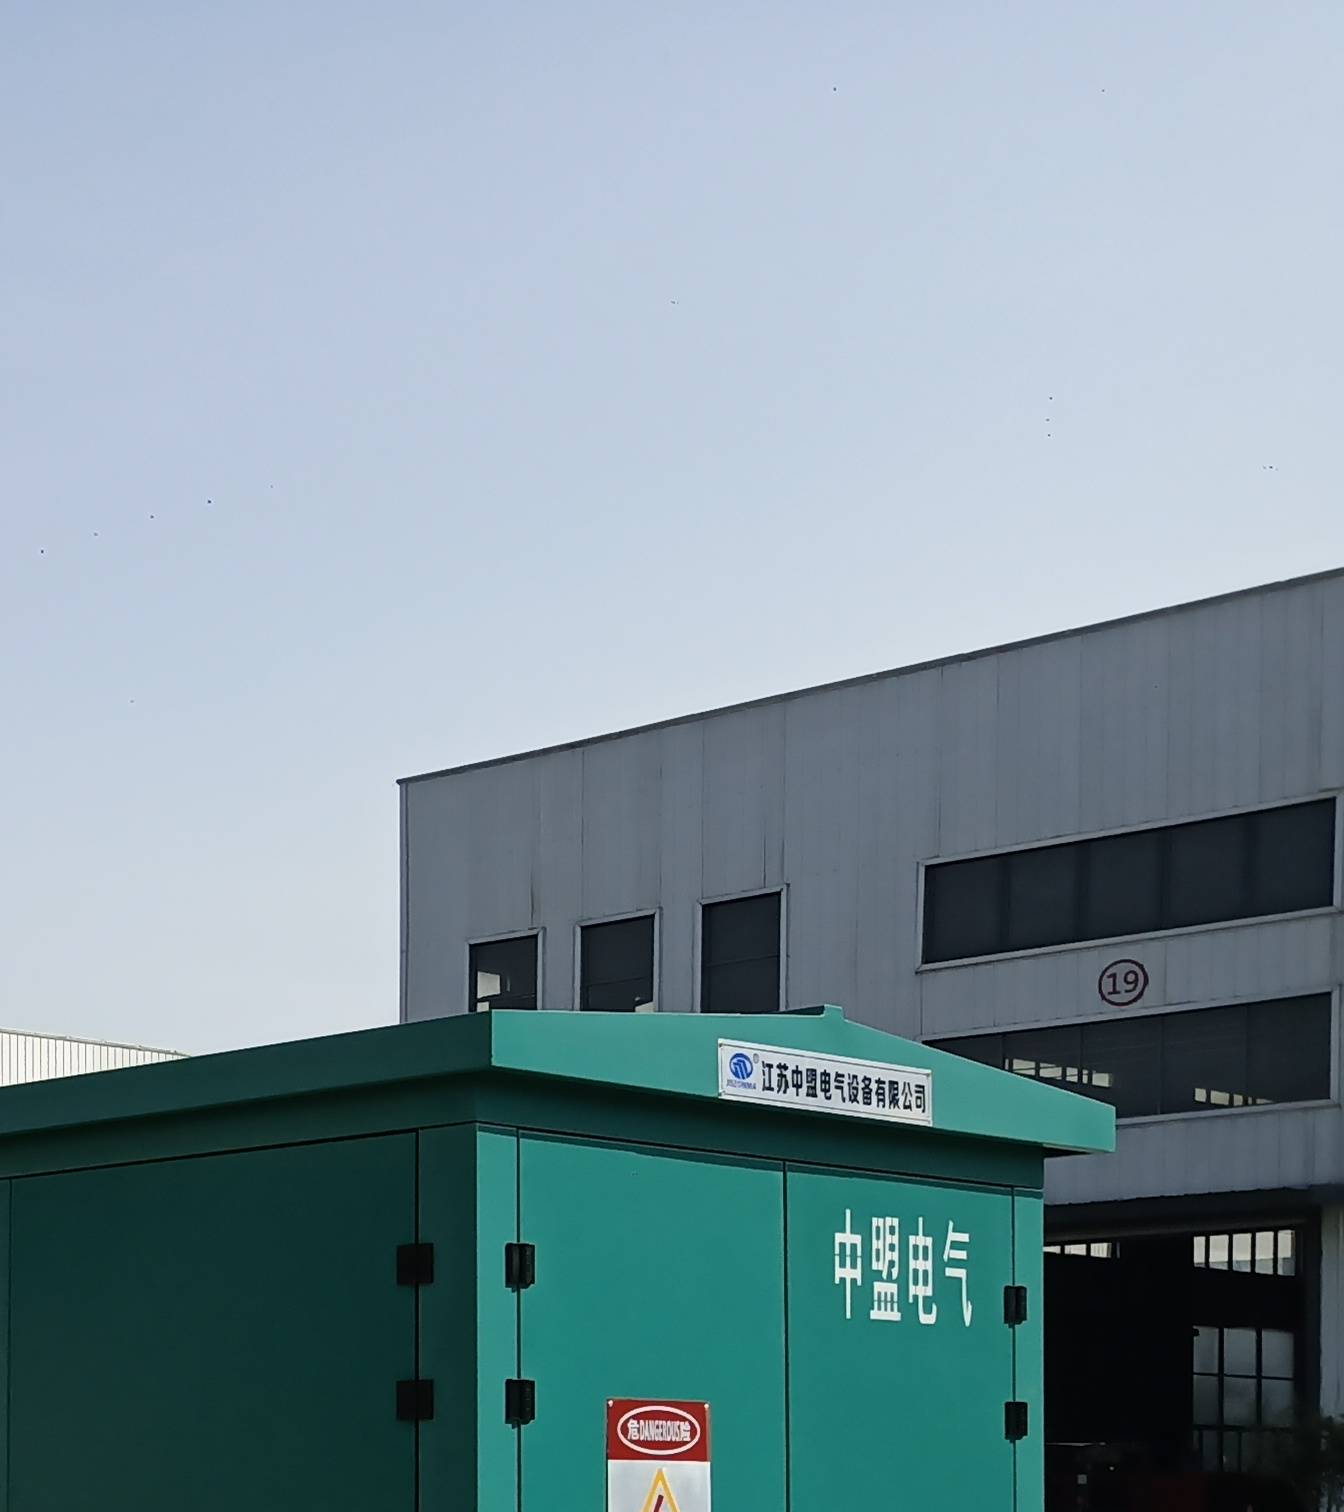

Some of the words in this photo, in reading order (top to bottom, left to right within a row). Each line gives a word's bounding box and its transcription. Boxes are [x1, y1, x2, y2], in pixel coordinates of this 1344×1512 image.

[1106, 969, 1139, 995] 19
[761, 1061, 926, 1114] 江苏中盟电气设备有限公司
[834, 1208, 972, 1327] 中盟电气
